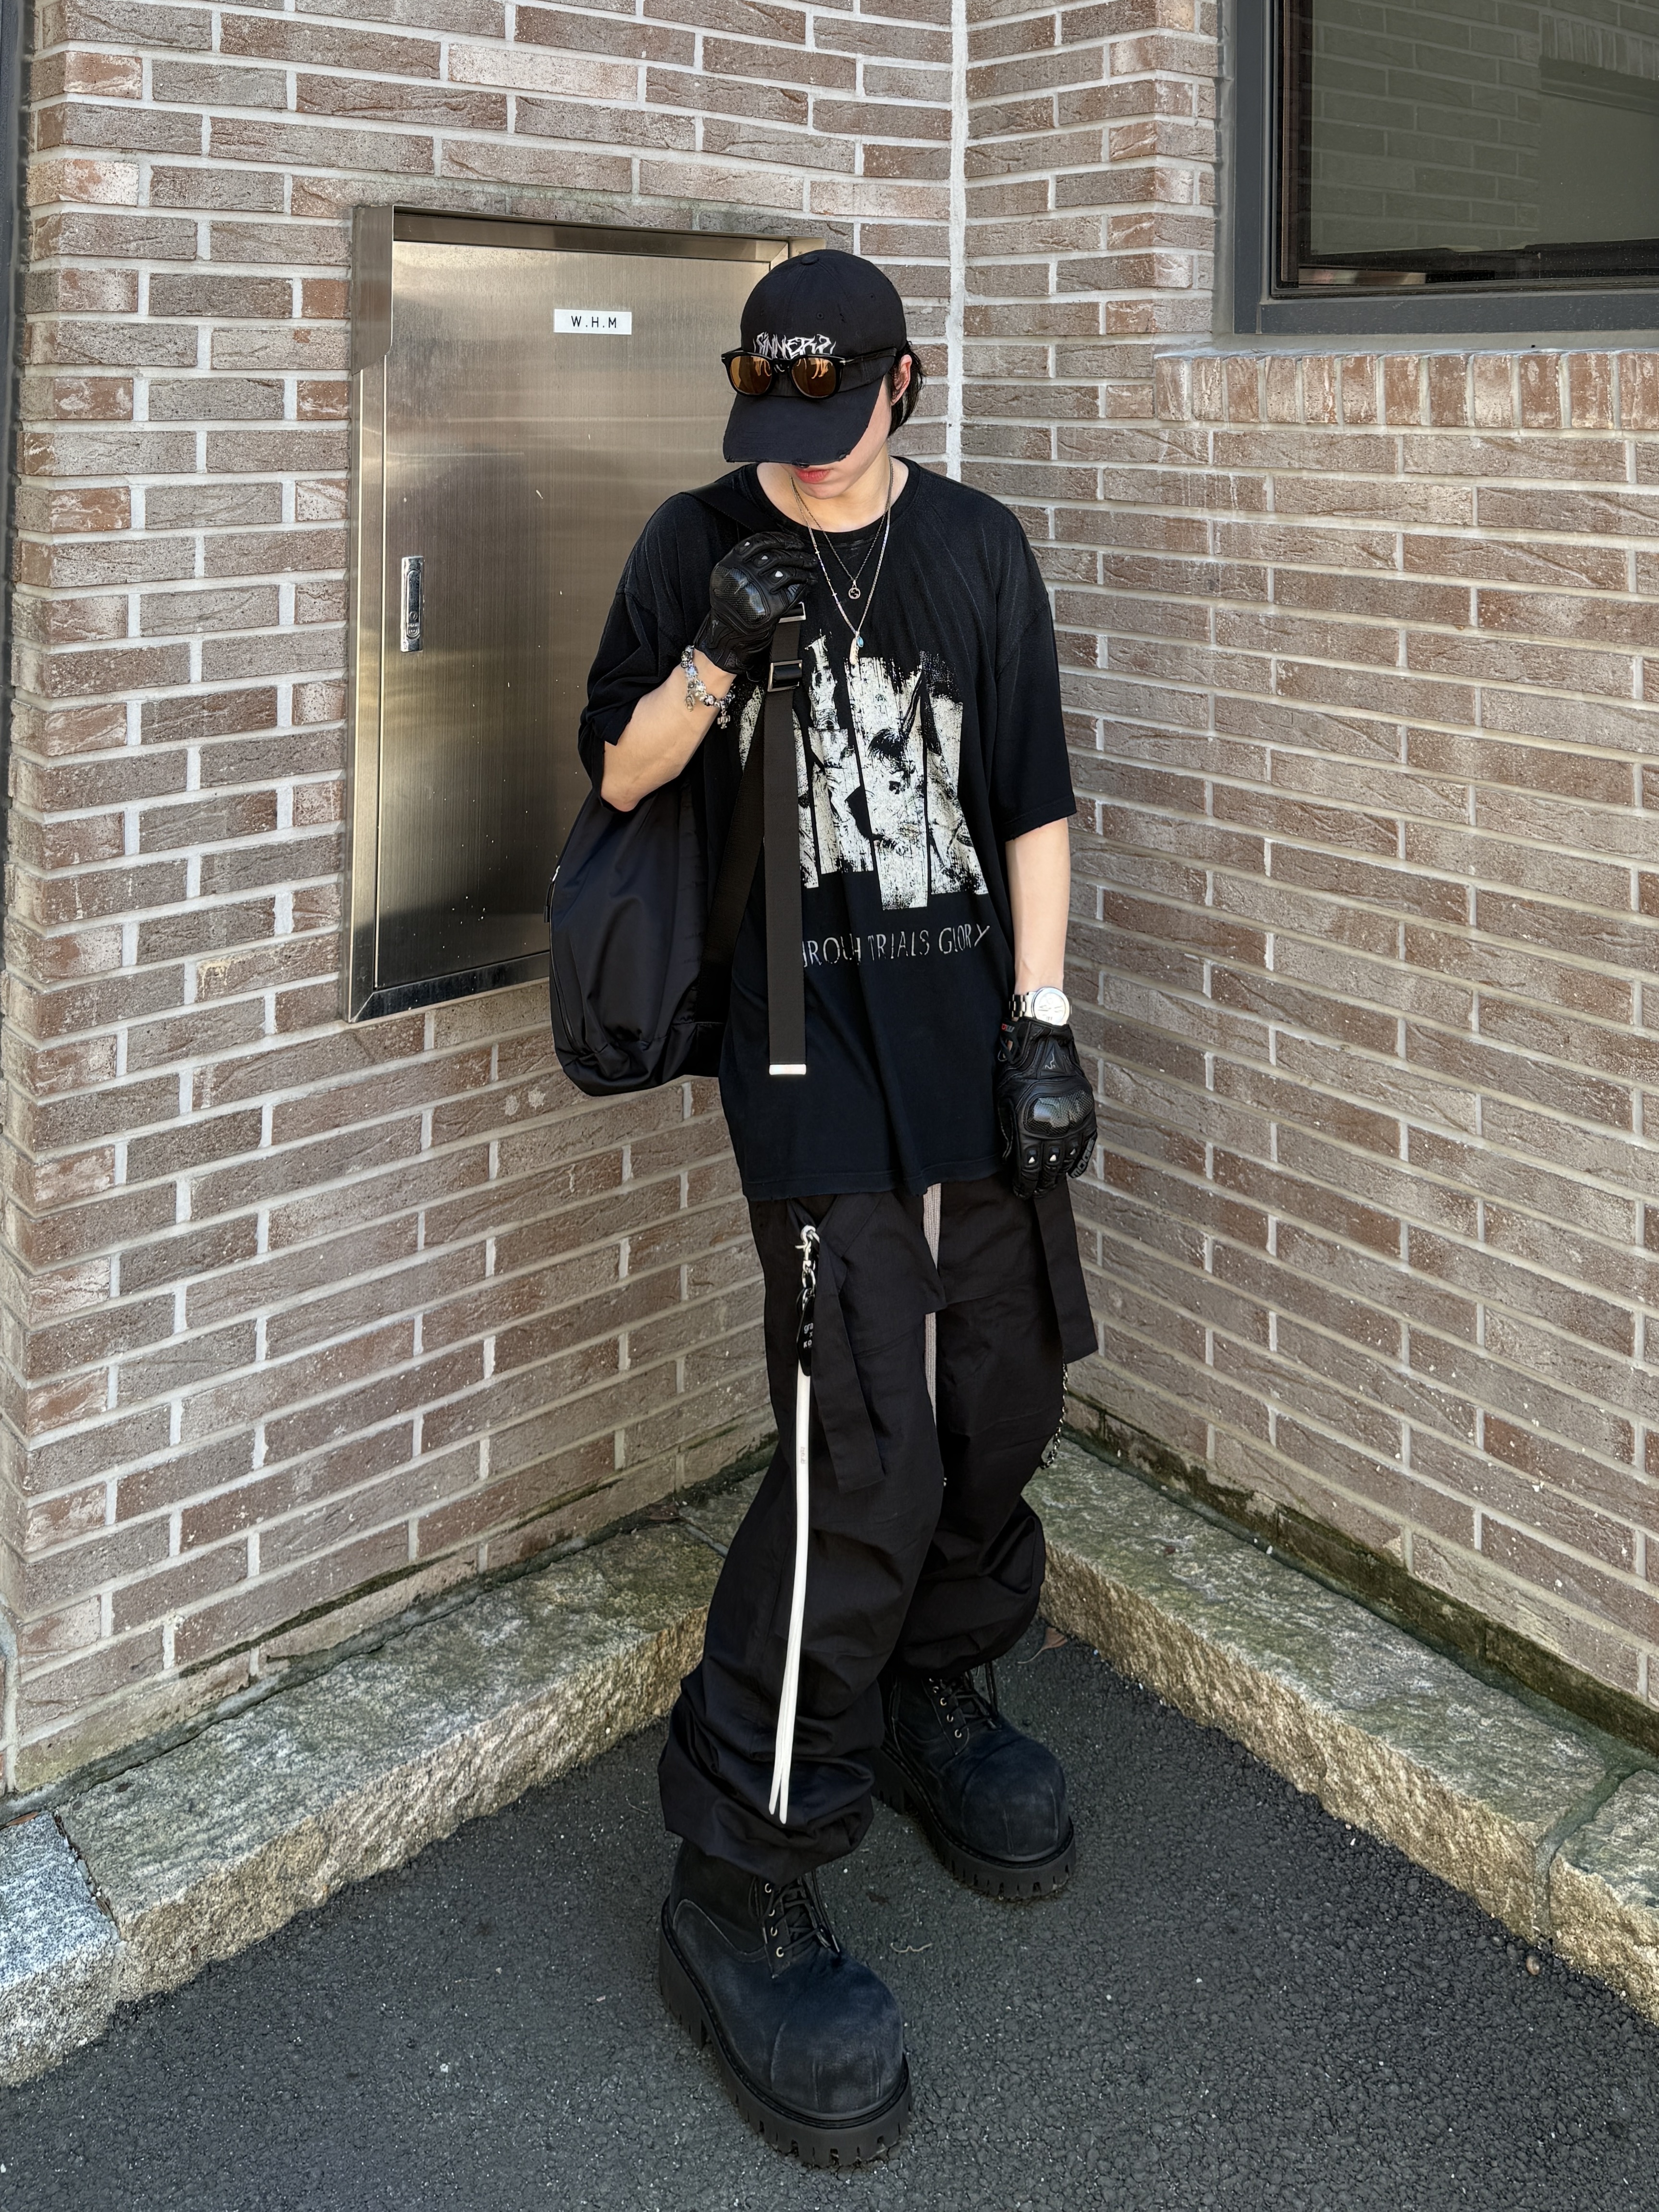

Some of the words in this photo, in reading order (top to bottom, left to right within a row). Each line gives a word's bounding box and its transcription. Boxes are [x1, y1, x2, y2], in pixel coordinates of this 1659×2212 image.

[571, 315, 616, 328] W.H.M
[868, 930, 930, 961] TRIALS
[938, 923, 990, 954] GLORY
